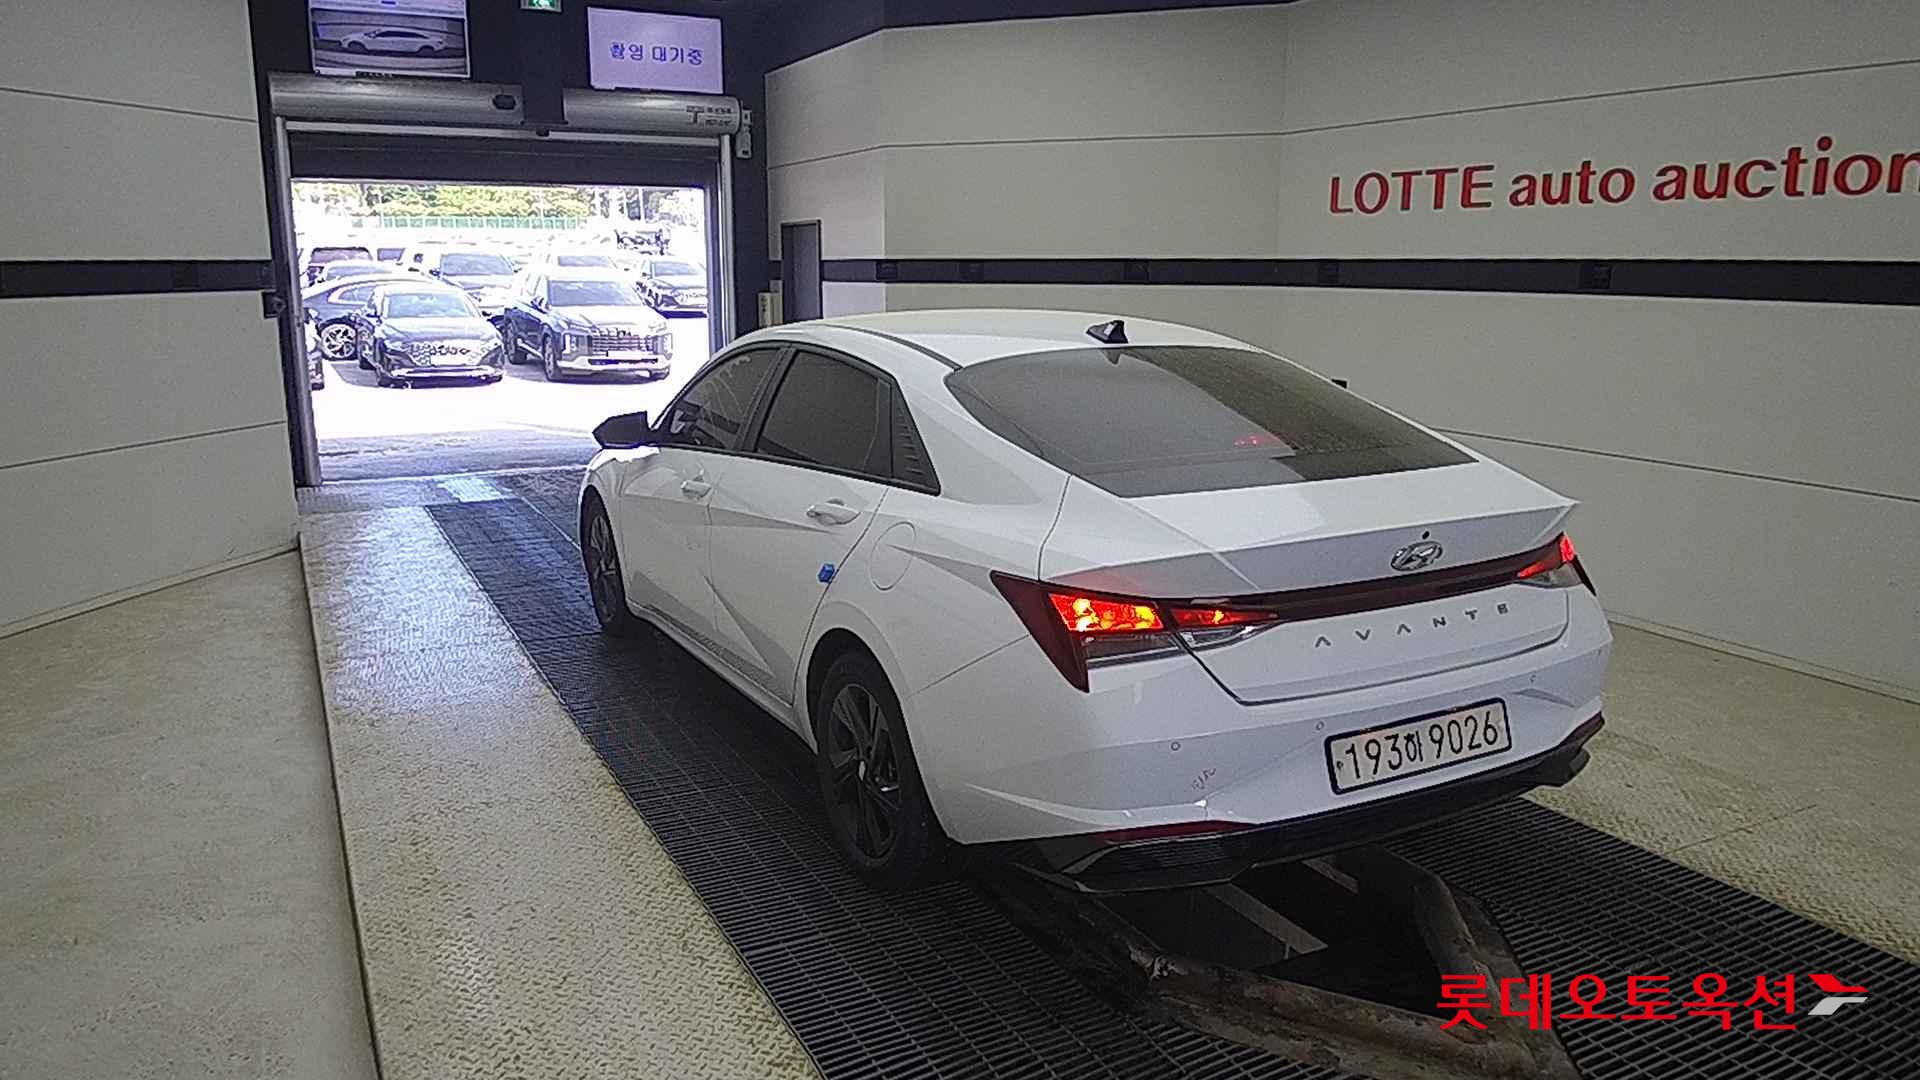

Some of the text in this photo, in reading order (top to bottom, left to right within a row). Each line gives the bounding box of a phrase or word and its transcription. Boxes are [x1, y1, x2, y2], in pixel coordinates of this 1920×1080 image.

[652, 45, 703, 66] 대기중
[1329, 164, 1495, 215] LOTTE
[1508, 160, 1635, 206] auto
[1315, 603, 1508, 648] AVANTE
